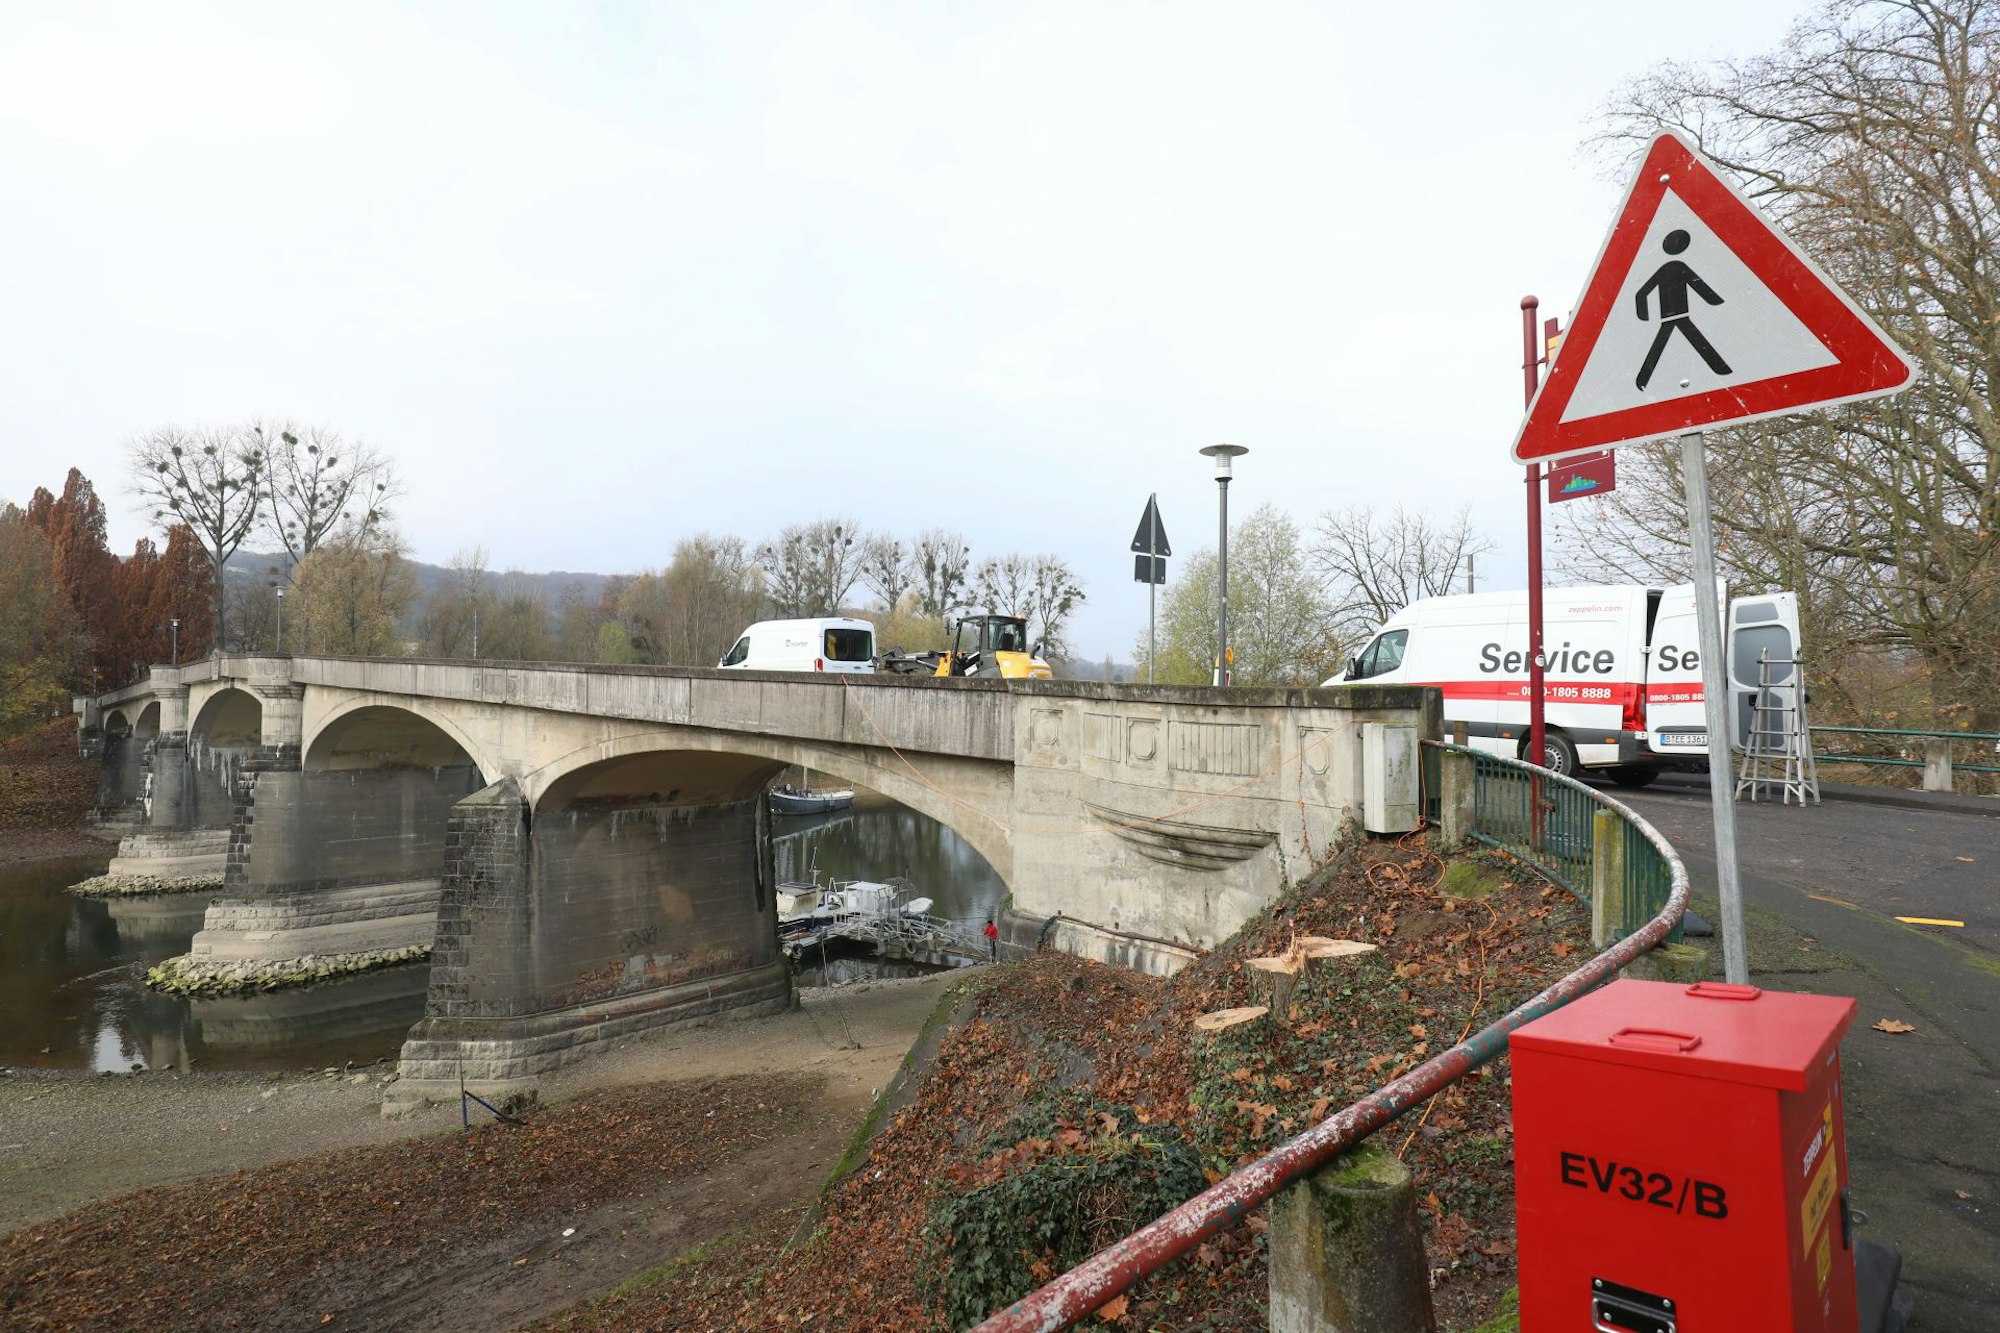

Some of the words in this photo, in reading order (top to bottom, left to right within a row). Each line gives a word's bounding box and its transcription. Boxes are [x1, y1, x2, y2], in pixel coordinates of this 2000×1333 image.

[1568, 604, 1622, 614] zeppelin.com
[1658, 645, 1700, 671] Se
[1581, 688, 1611, 699] 8888
[1649, 693, 1690, 702] 0800-1805
[1561, 1152, 1728, 1219] EV32/B
